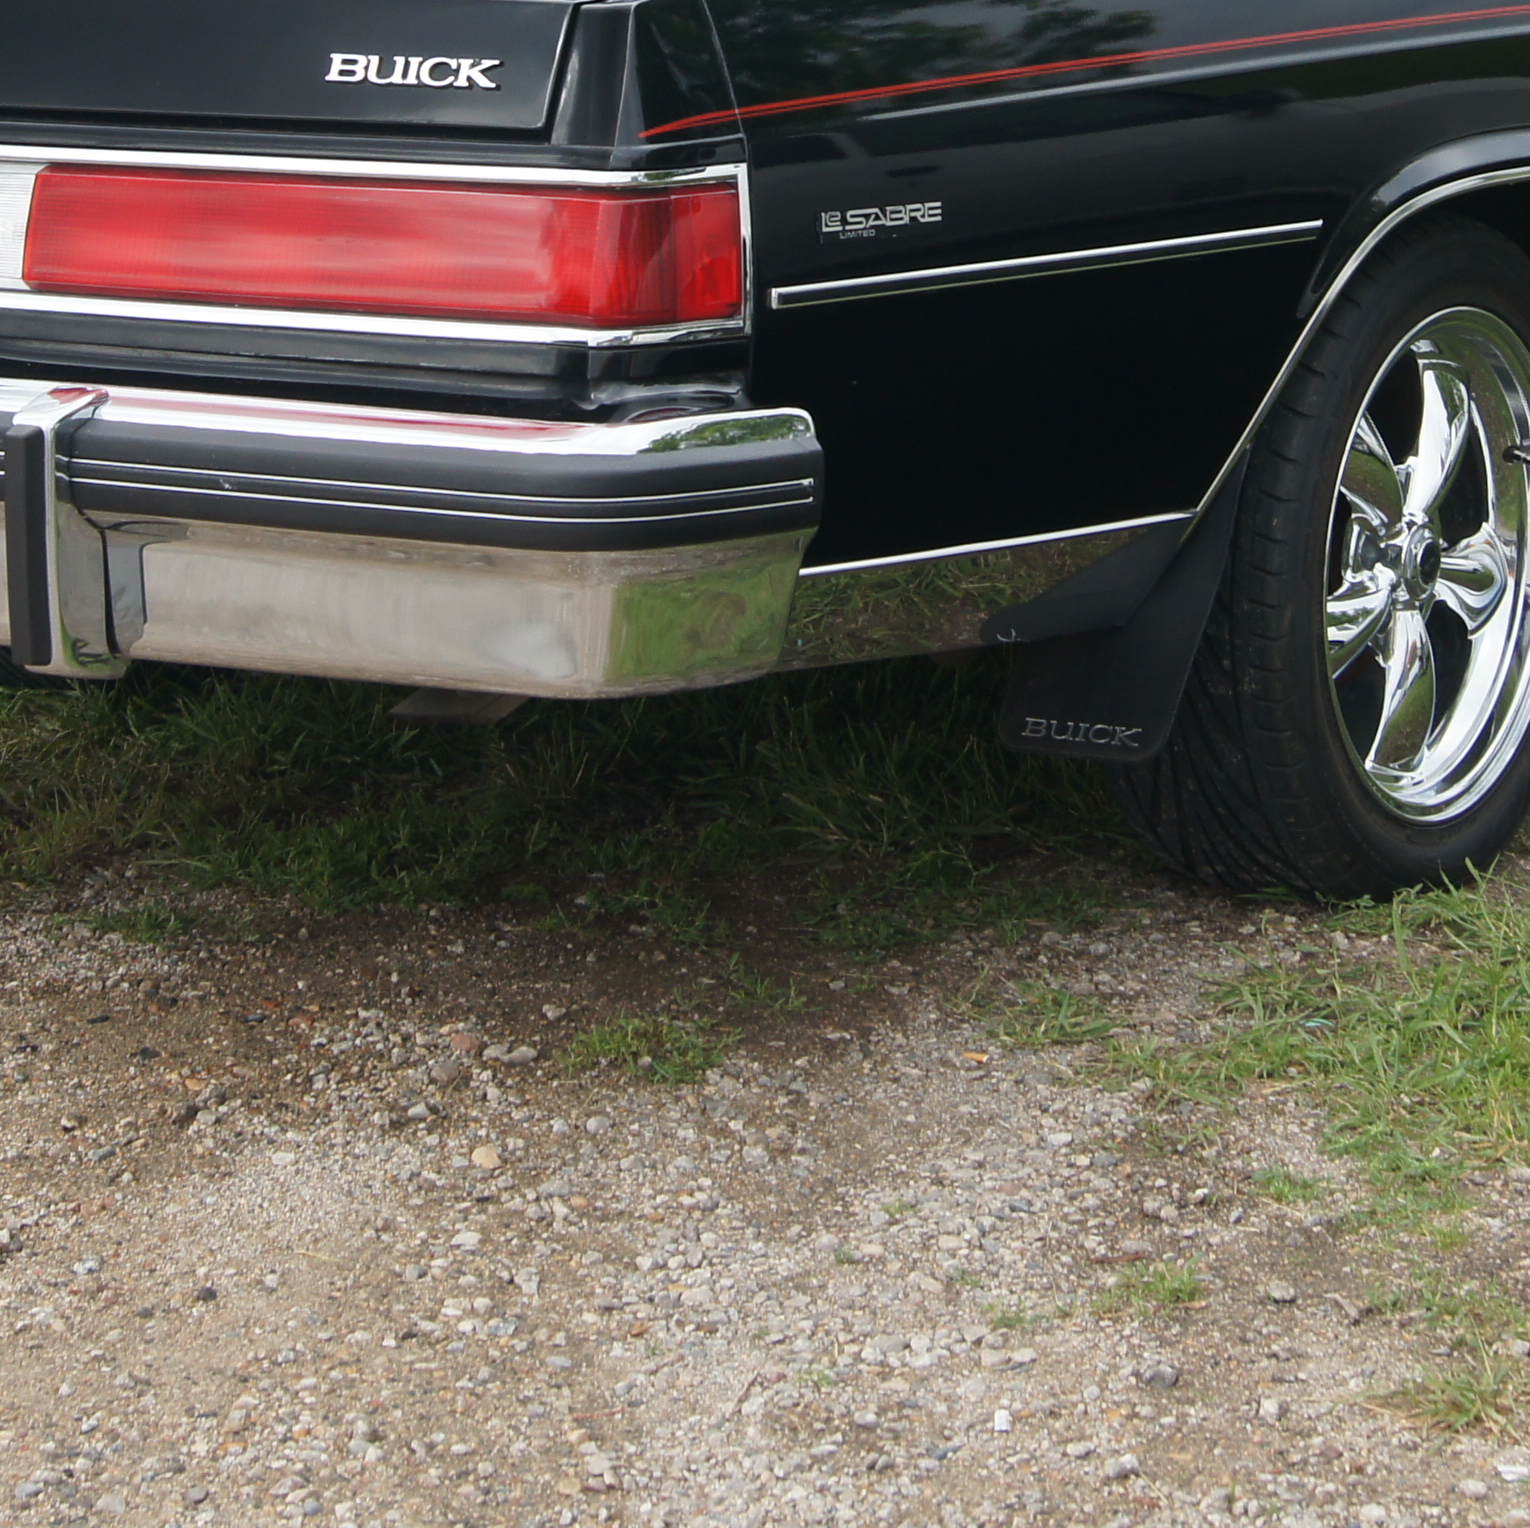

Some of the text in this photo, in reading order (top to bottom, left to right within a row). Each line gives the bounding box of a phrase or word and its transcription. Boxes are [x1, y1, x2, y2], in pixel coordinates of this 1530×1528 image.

[324, 52, 502, 89] BUICK
[839, 229, 876, 239] LIMITED
[1021, 717, 1143, 747] BUICK
